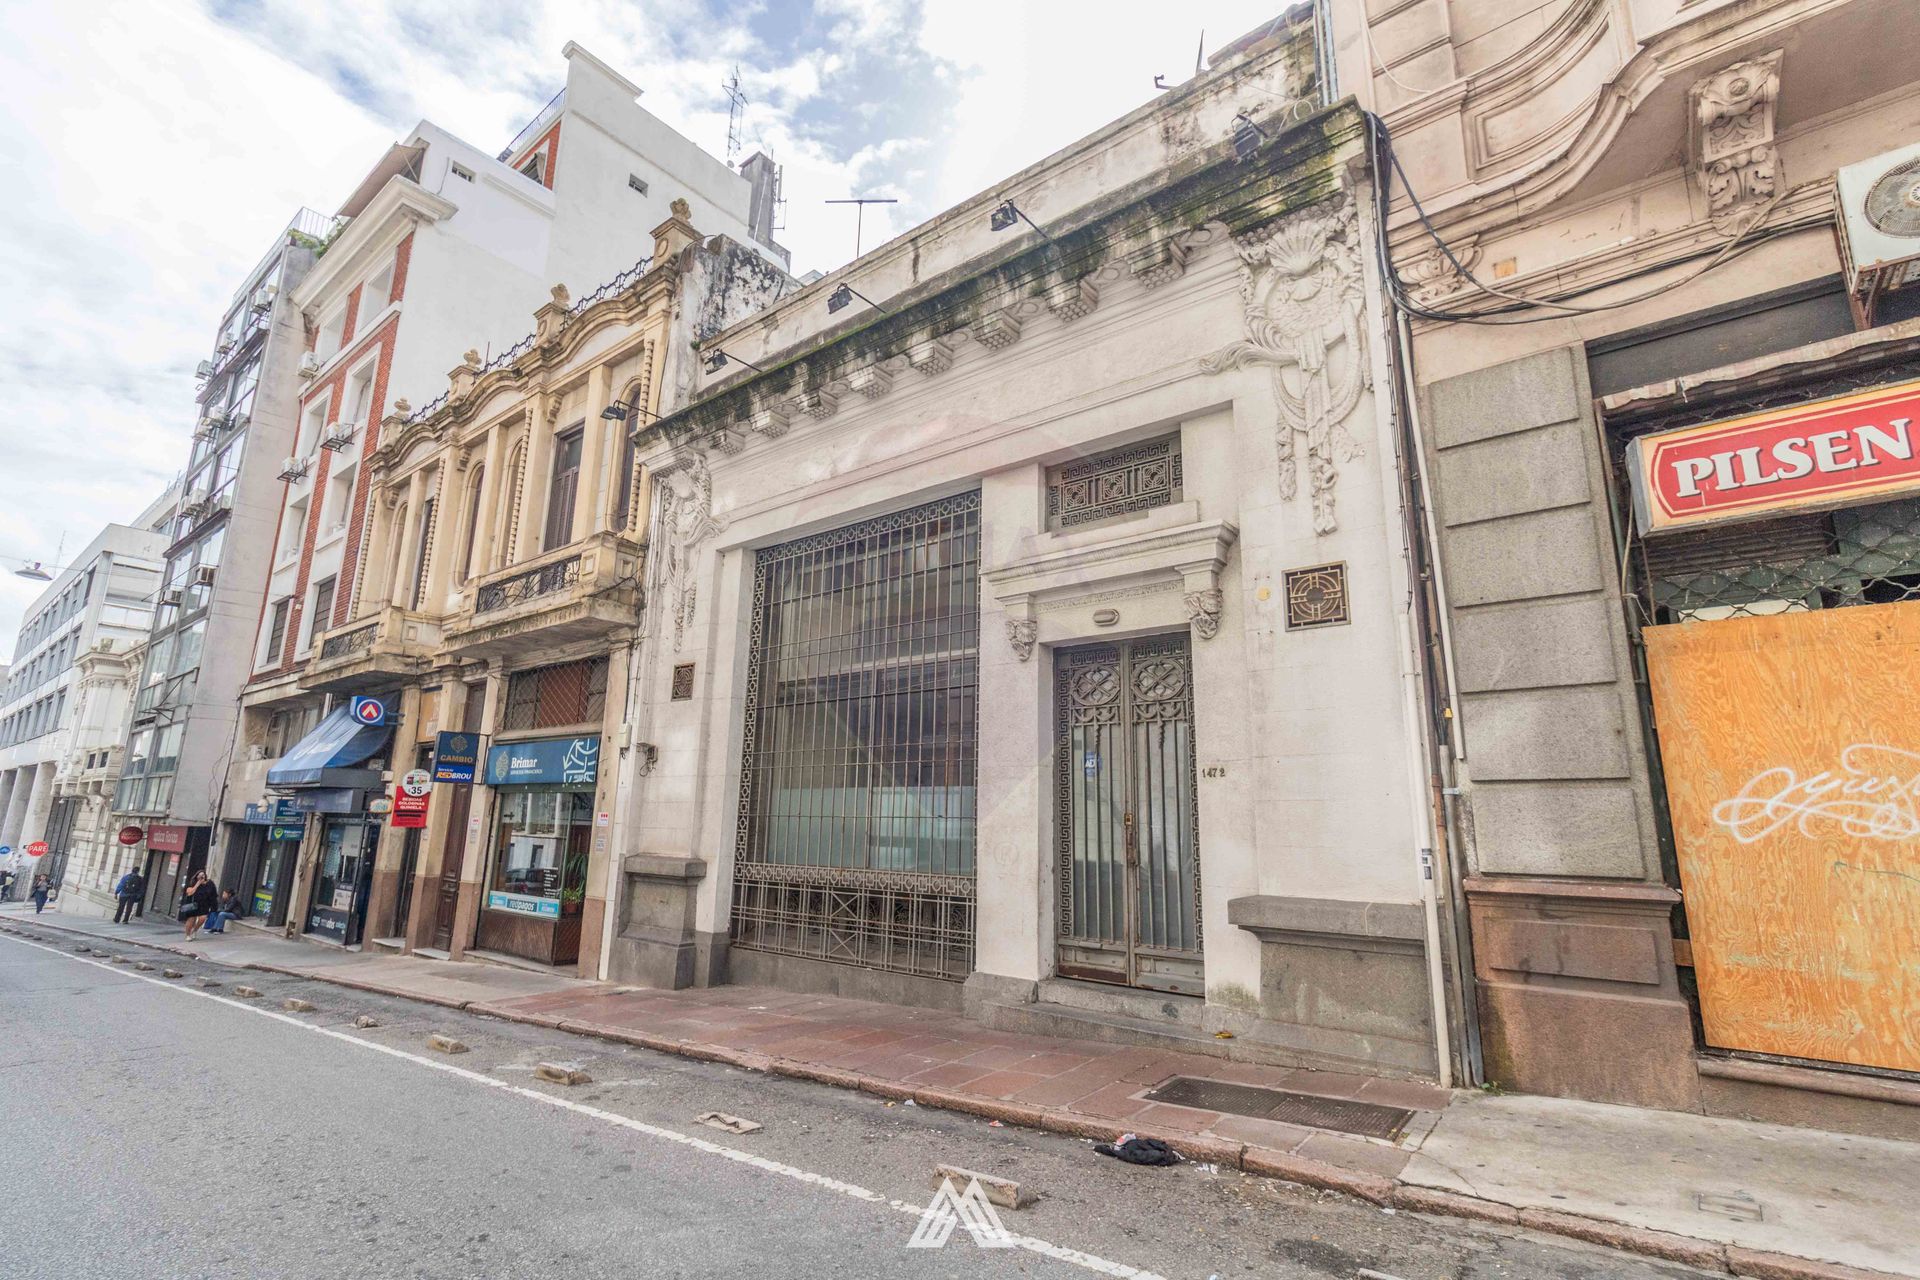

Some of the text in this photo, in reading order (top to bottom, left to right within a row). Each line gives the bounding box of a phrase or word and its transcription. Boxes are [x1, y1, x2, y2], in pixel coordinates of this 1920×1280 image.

[1671, 418, 1913, 498] PILSEN
[440, 754, 474, 763] CAMBIO
[510, 757, 538, 769] Brimar
[436, 771, 472, 780] REDBROU
[1201, 767, 1226, 778] 1472
